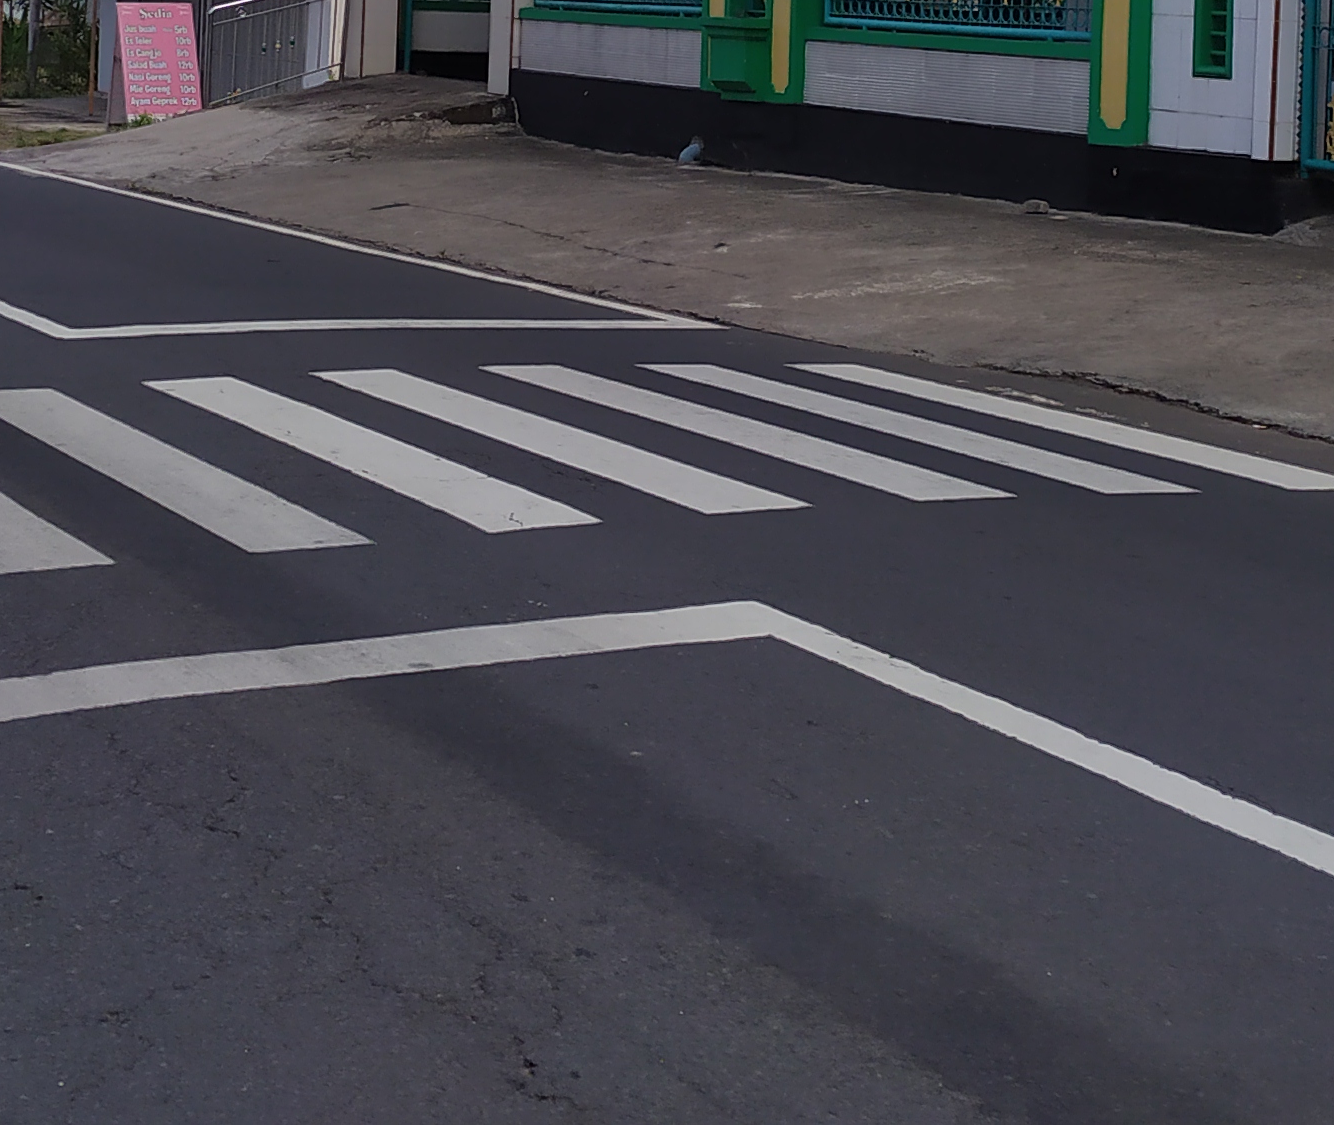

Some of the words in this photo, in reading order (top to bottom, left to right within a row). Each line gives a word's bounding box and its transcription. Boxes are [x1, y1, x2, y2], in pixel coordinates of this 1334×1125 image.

[139, 7, 173, 20] Sedia
[175, 36, 192, 45] 10rb
[127, 60, 148, 69] Salad
[128, 73, 145, 81] Nasi
[145, 72, 172, 84] Goreng
[179, 73, 196, 82] 10rb
[129, 84, 144, 93] Mie
[144, 84, 171, 95] Goreng
[180, 85, 197, 94] 10rb
[130, 96, 151, 107] Ayam
[151, 96, 178, 107] Geprek
